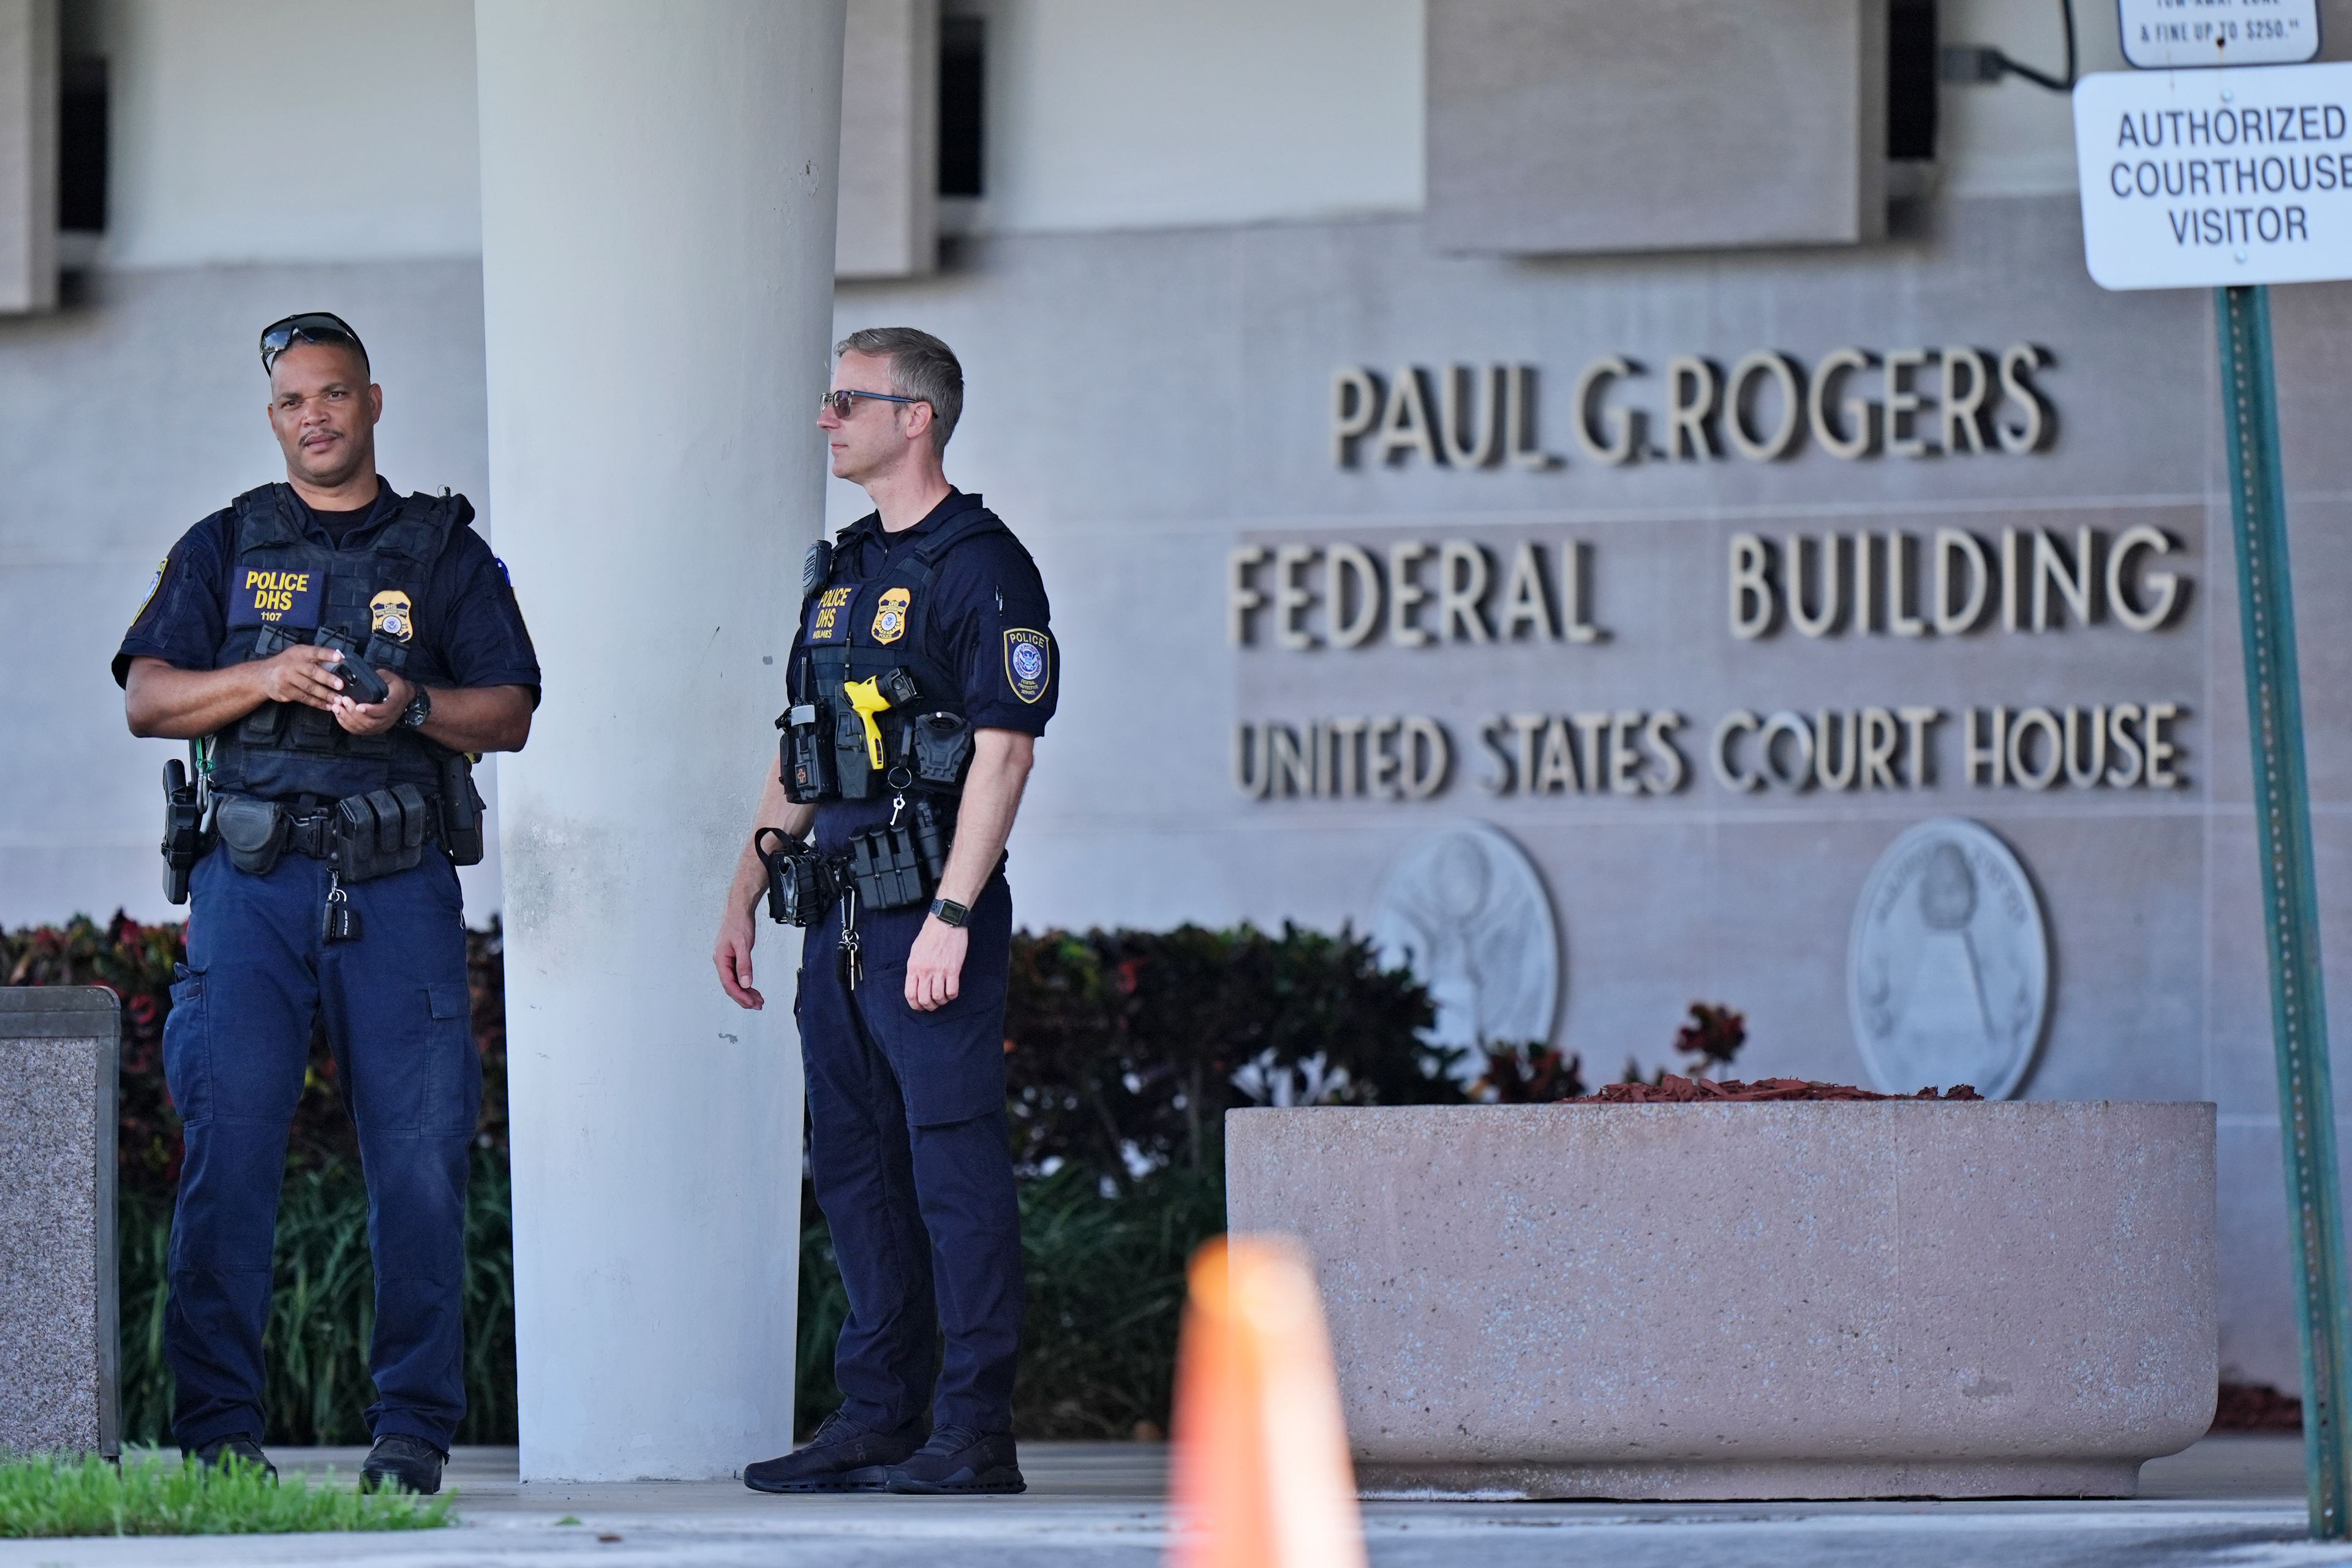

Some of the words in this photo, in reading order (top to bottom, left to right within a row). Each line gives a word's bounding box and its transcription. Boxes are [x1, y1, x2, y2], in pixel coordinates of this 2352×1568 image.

[2156, 23, 2187, 41] FINE
[2193, 21, 2212, 40] UP
[2219, 21, 2237, 40] TO
[2117, 105, 2347, 148] AUTHORIZED
[2111, 153, 2352, 198] COURTHOUSE
[2168, 205, 2309, 245] VISITOR
[1330, 364, 1556, 468] PAUL
[246, 571, 309, 592] POLICE
[1230, 538, 1606, 649] FEDERAL
[1728, 523, 2184, 639] BUILDING
[254, 590, 293, 611] DHS
[817, 588, 852, 609] POLICE
[261, 611, 282, 621] 1107
[816, 608, 837, 628] DHS
[813, 629, 832, 639] HOLMES
[1010, 633, 1044, 648] POLICE
[1235, 715, 1455, 799] UNITED
[1475, 709, 1689, 797] STATES
[1714, 705, 1945, 794] COURT
[1964, 702, 2183, 791] HOUSE
